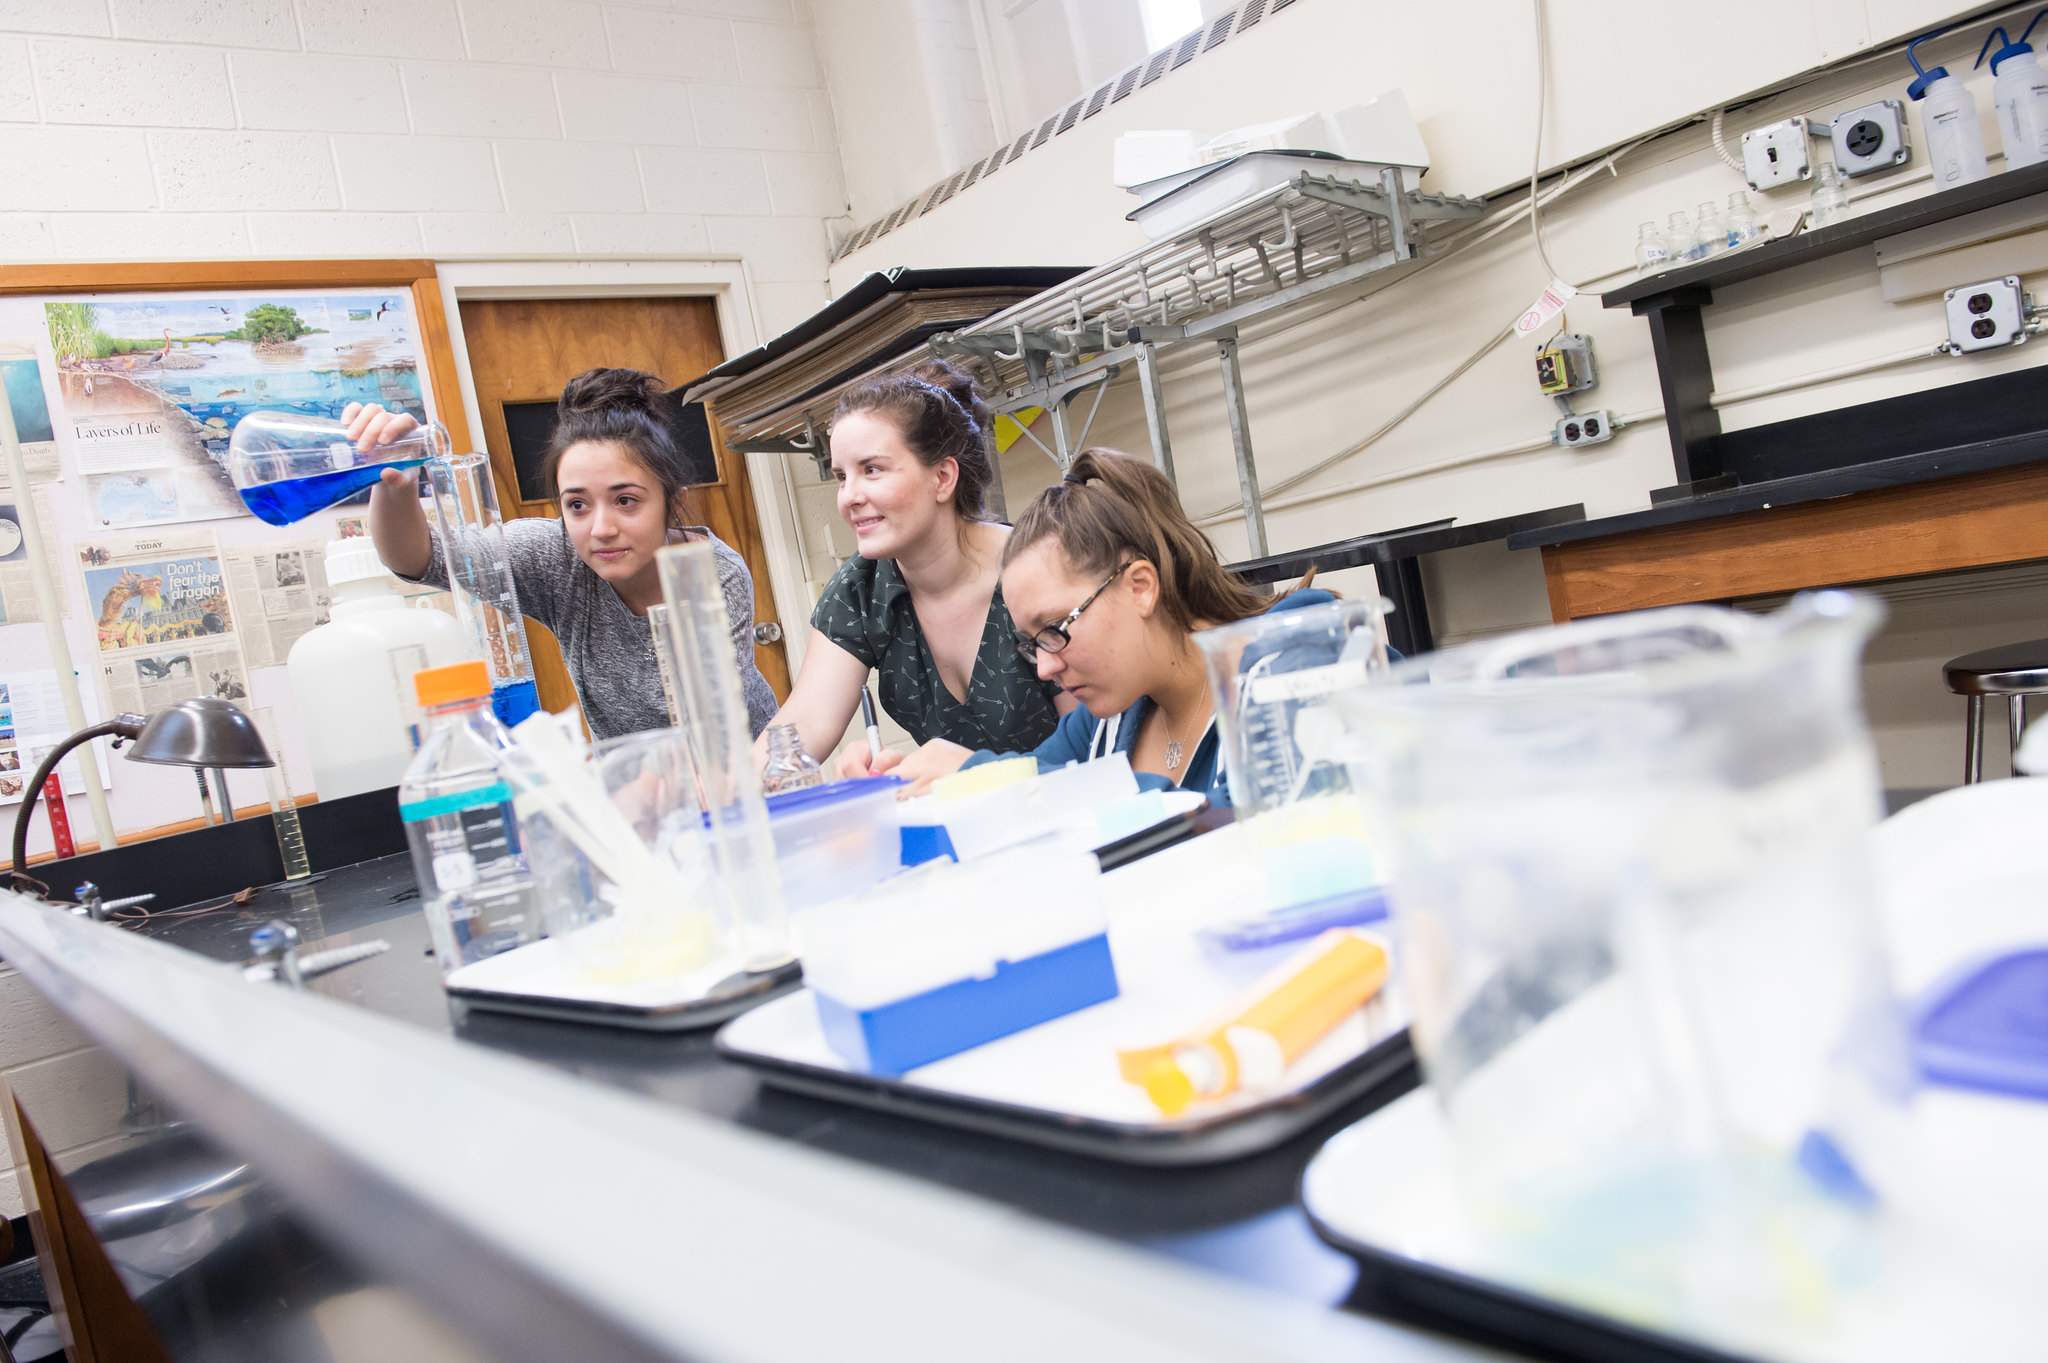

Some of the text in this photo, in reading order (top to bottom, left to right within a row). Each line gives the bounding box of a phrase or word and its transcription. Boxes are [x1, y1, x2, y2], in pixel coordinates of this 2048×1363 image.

[76, 420, 161, 442] Layers of Life
[134, 542, 163, 551] TODAY
[167, 560, 202, 576] Don't
[169, 572, 220, 591] fear the
[171, 585, 220, 601] dragon
[104, 666, 113, 675] H
